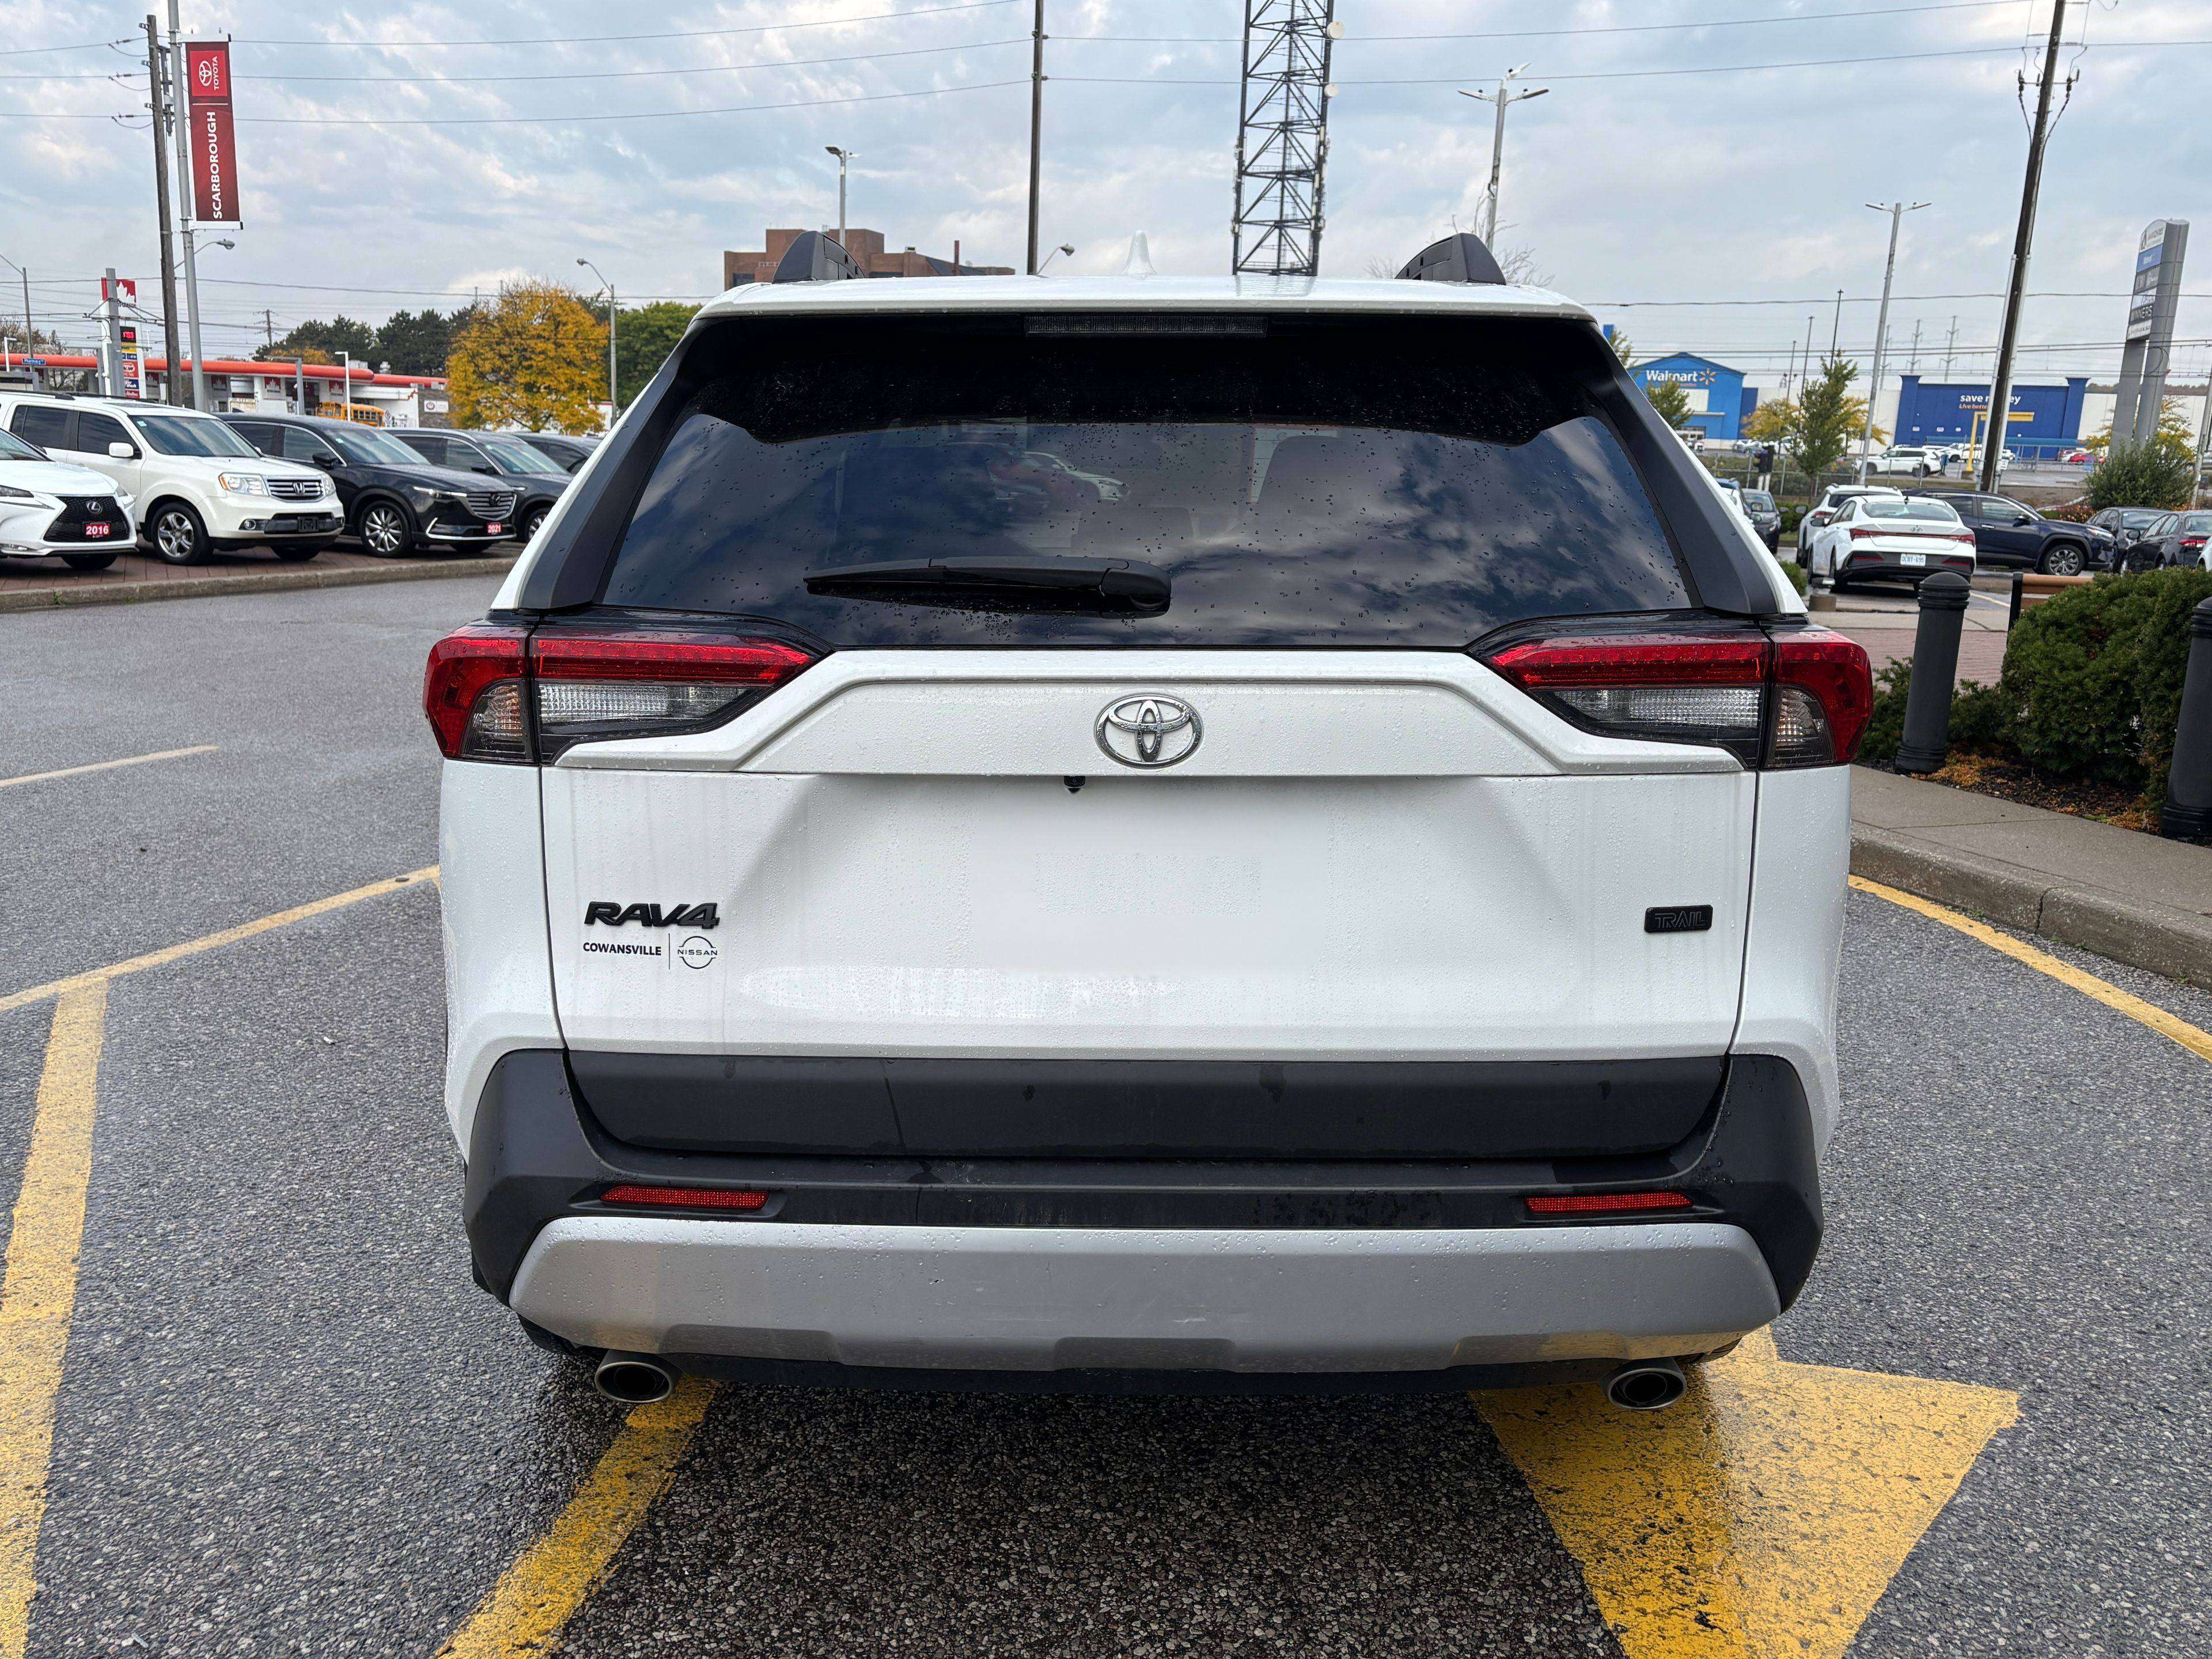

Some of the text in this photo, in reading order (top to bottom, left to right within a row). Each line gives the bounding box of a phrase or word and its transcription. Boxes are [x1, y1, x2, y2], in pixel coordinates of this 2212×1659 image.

[207, 112, 222, 219] SCARBOROUGH
[1646, 369, 1698, 382] Walmart
[85, 525, 108, 535] 2016
[584, 902, 720, 929] RAV4
[1654, 911, 1706, 928] TRAIL
[583, 942, 661, 956] COWANSVILLE
